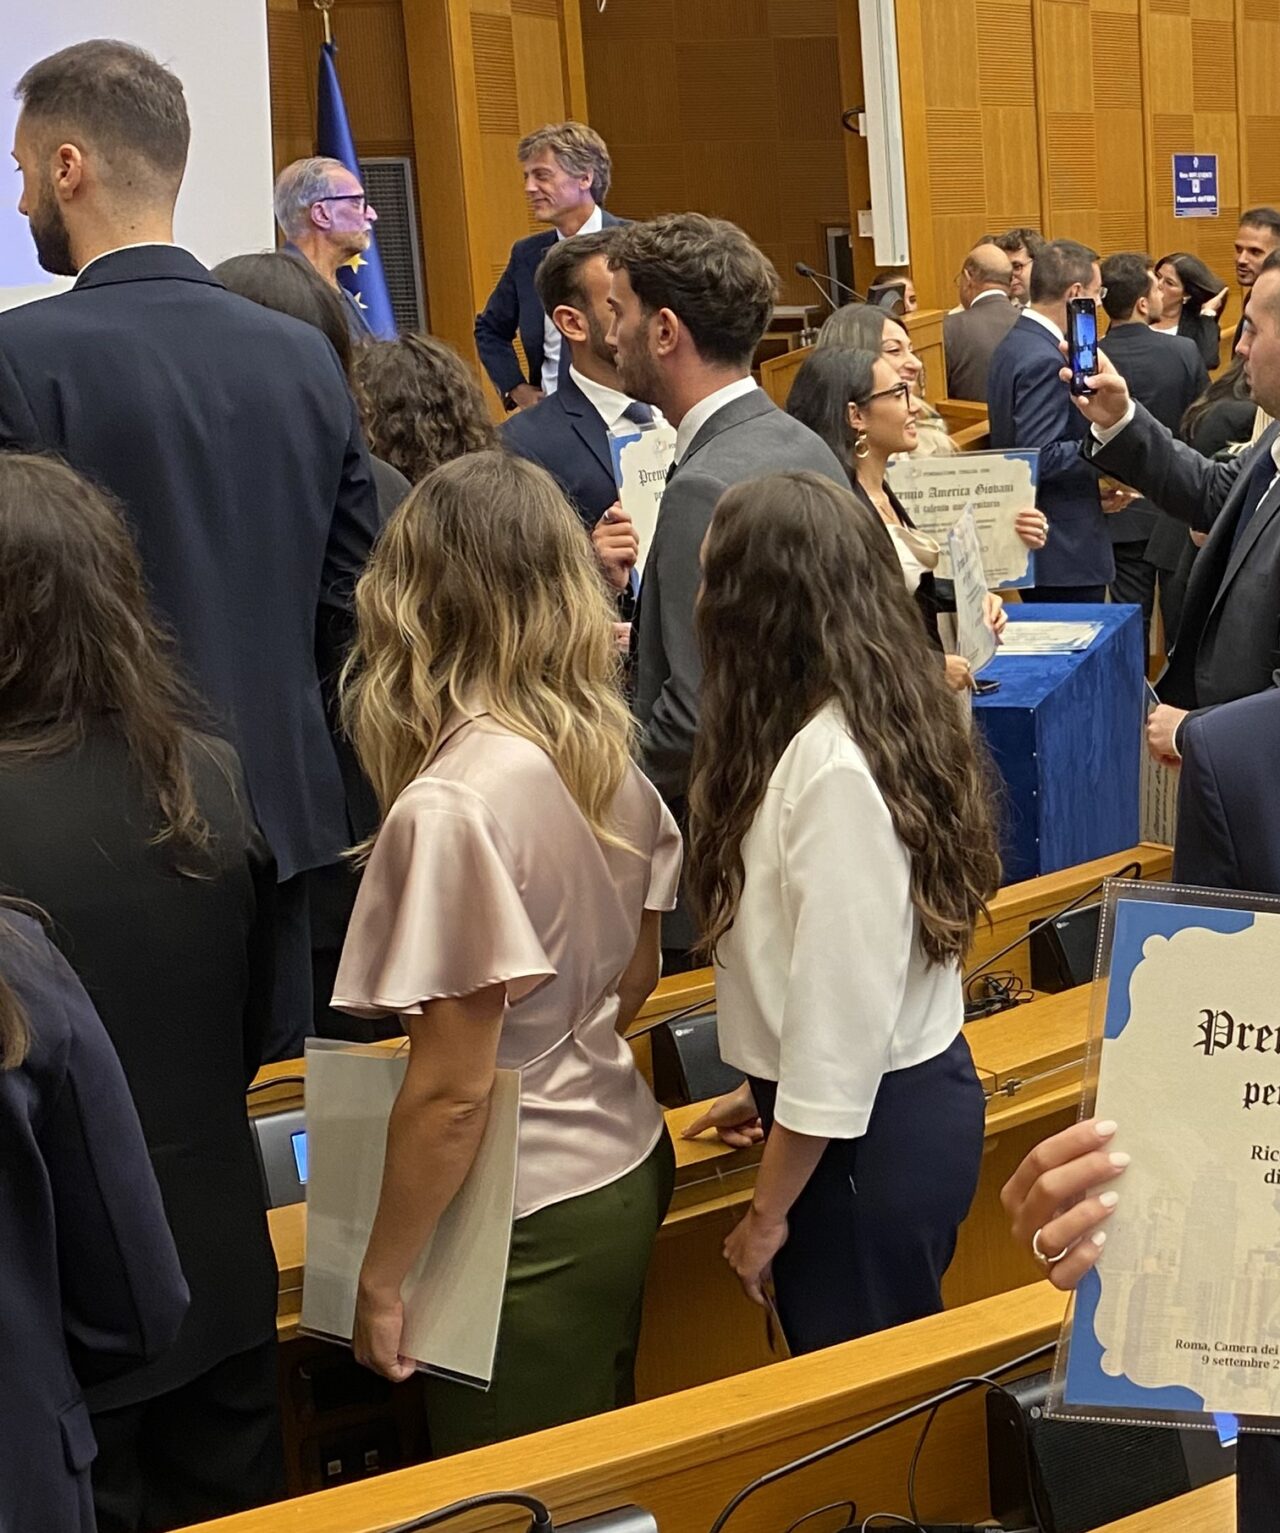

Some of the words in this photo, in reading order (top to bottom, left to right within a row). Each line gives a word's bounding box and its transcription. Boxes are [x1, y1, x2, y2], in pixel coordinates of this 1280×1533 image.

[1176, 1339, 1211, 1352] Roma,
[1214, 1341, 1258, 1355] Camera
[1261, 1344, 1278, 1356] dei
[1201, 1354, 1210, 1364] 9
[1213, 1356, 1270, 1369] settembre
